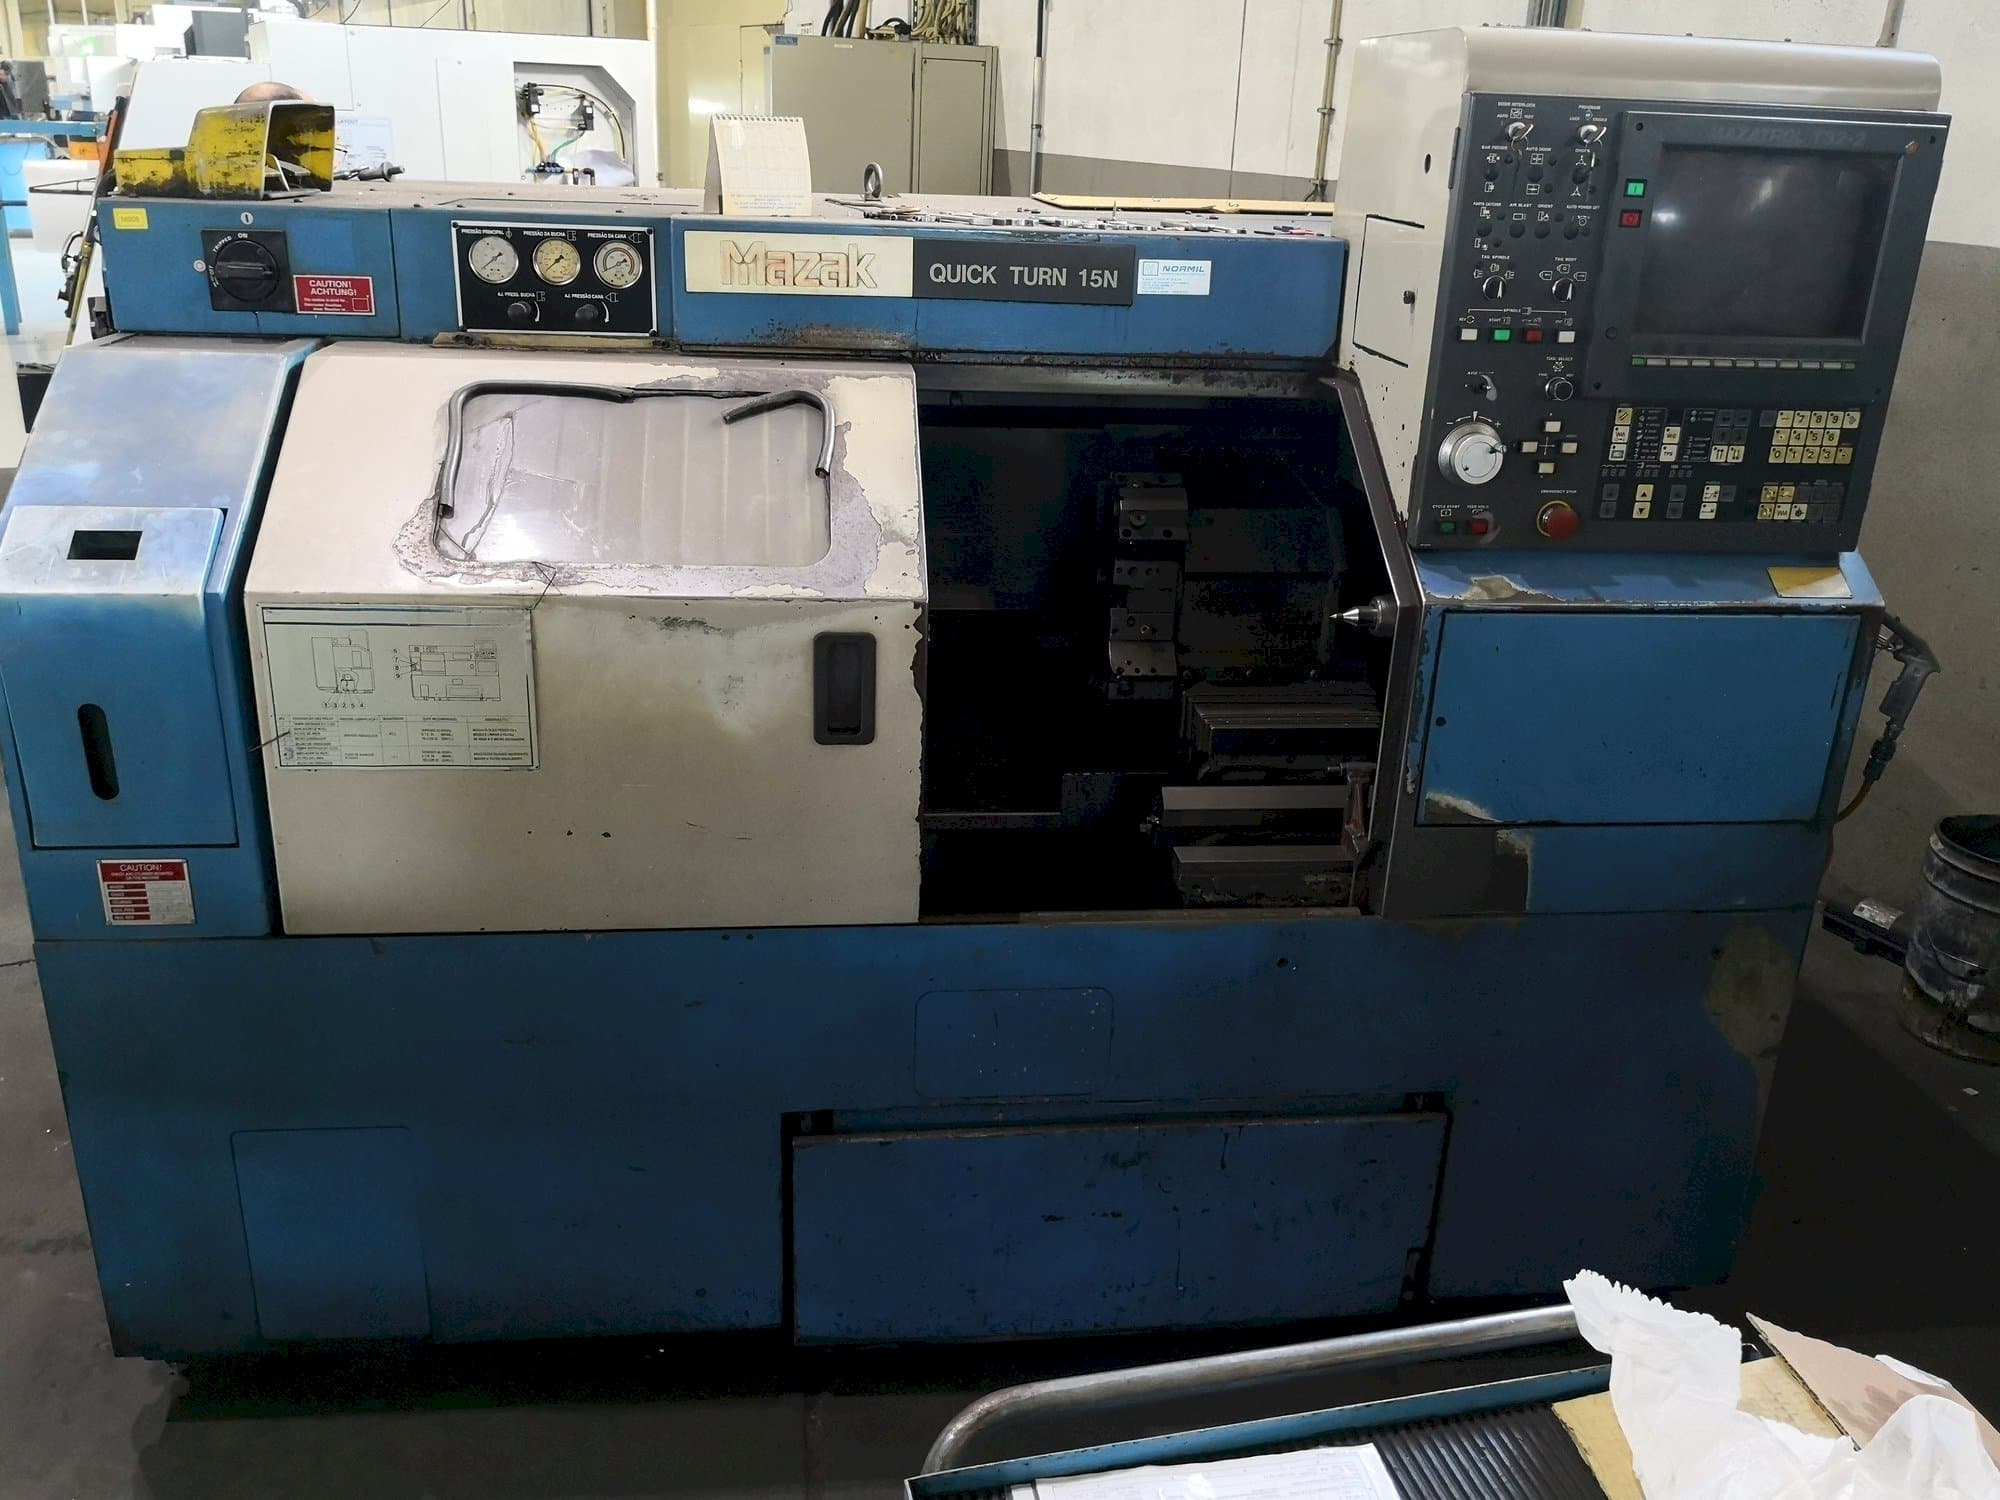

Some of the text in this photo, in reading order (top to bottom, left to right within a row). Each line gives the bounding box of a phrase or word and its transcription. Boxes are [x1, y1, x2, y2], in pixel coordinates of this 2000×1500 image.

[720, 240, 877, 288] Mazak
[1162, 265, 1205, 273] NORMIL
[929, 262, 998, 284] QUICK
[1009, 266, 1067, 287] TURN
[1078, 269, 1119, 289] 15N
[309, 280, 352, 288] CAUTION!
[310, 288, 357, 296] ACHTUNG!
[1799, 415, 1805, 423] 7
[1832, 416, 1839, 424] 9
[1808, 451, 1814, 459] 2
[1824, 451, 1830, 459] 3
